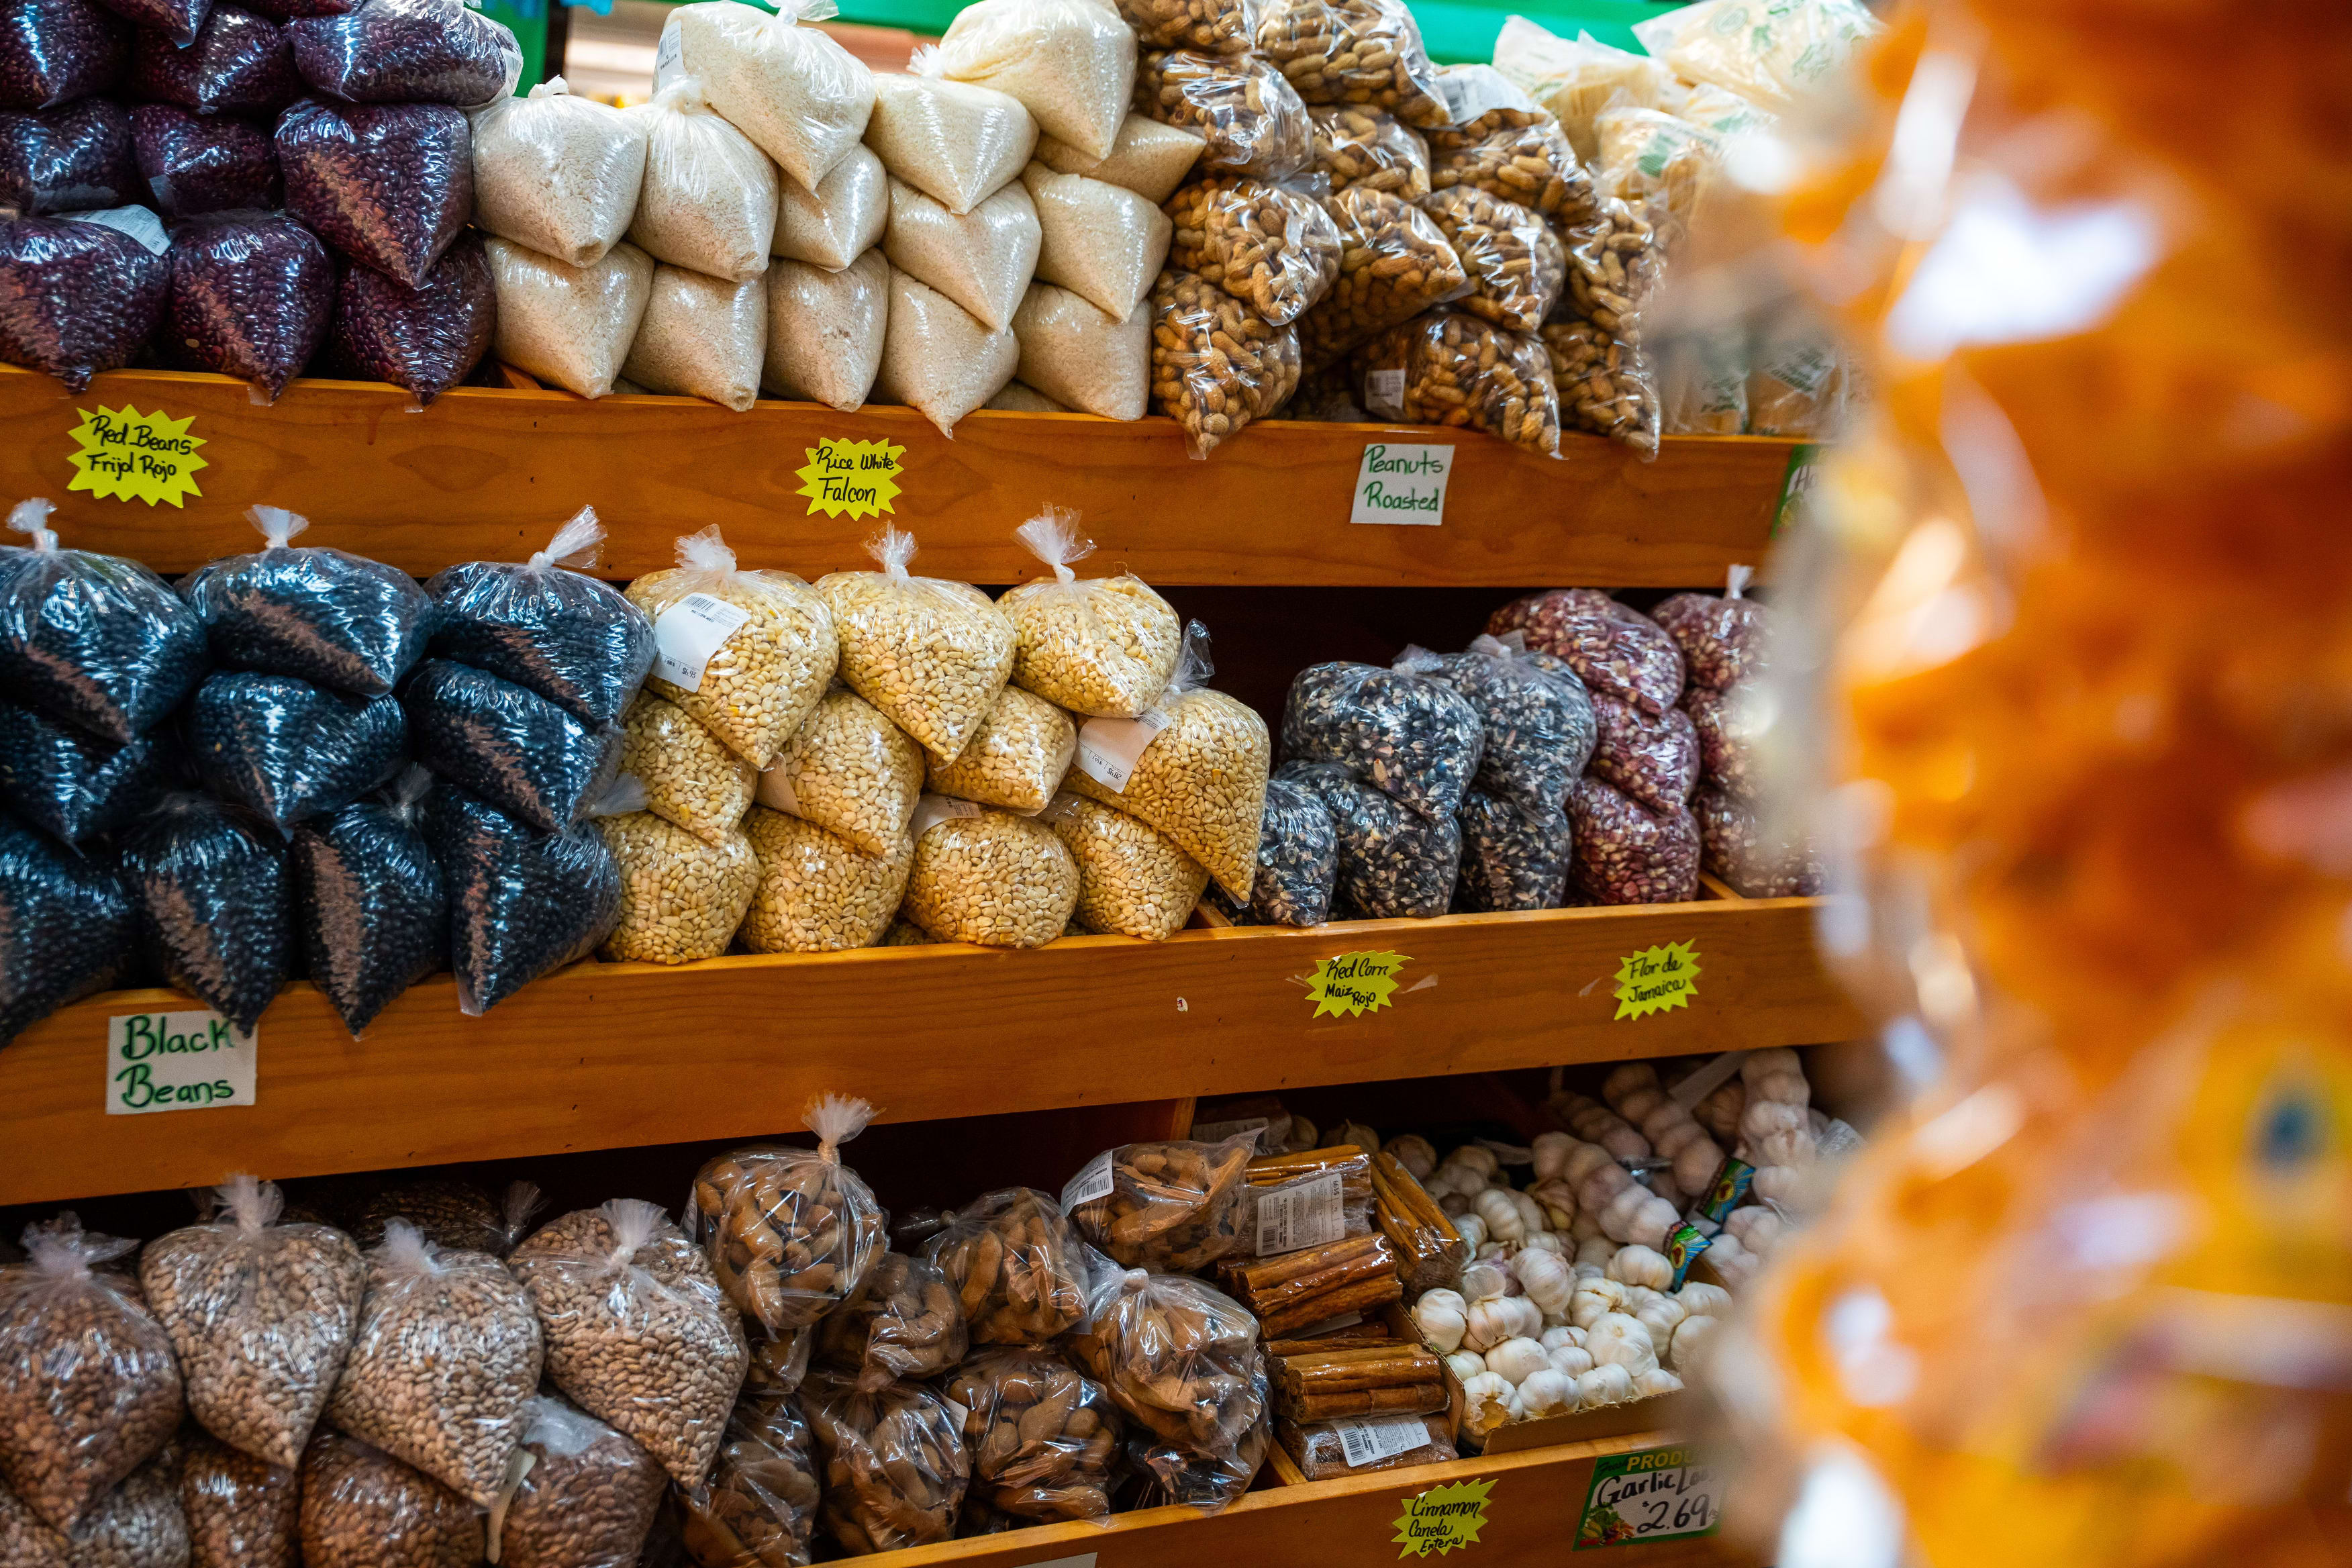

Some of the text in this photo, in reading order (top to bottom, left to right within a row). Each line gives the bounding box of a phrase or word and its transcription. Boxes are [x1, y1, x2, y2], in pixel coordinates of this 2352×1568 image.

[89, 415, 192, 455] Red Beans
[138, 455, 177, 483] Rojo
[816, 446, 894, 473] Rice White
[1365, 445, 1444, 476] Peanuts
[818, 477, 877, 506] Falcon
[1363, 481, 1439, 511] Roasted
[1326, 958, 1389, 981] Red Corn
[1628, 951, 1683, 979] Flor de
[1324, 983, 1376, 1008] Maiz Rojo
[1628, 979, 1687, 1003] Jamaica
[115, 1063, 234, 1108] Beans
[1597, 1472, 1676, 1508] Garlic
[1411, 1496, 1481, 1519] Cinnamon
[1408, 1518, 1454, 1538] Canela
[1420, 1534, 1464, 1553] Entera
